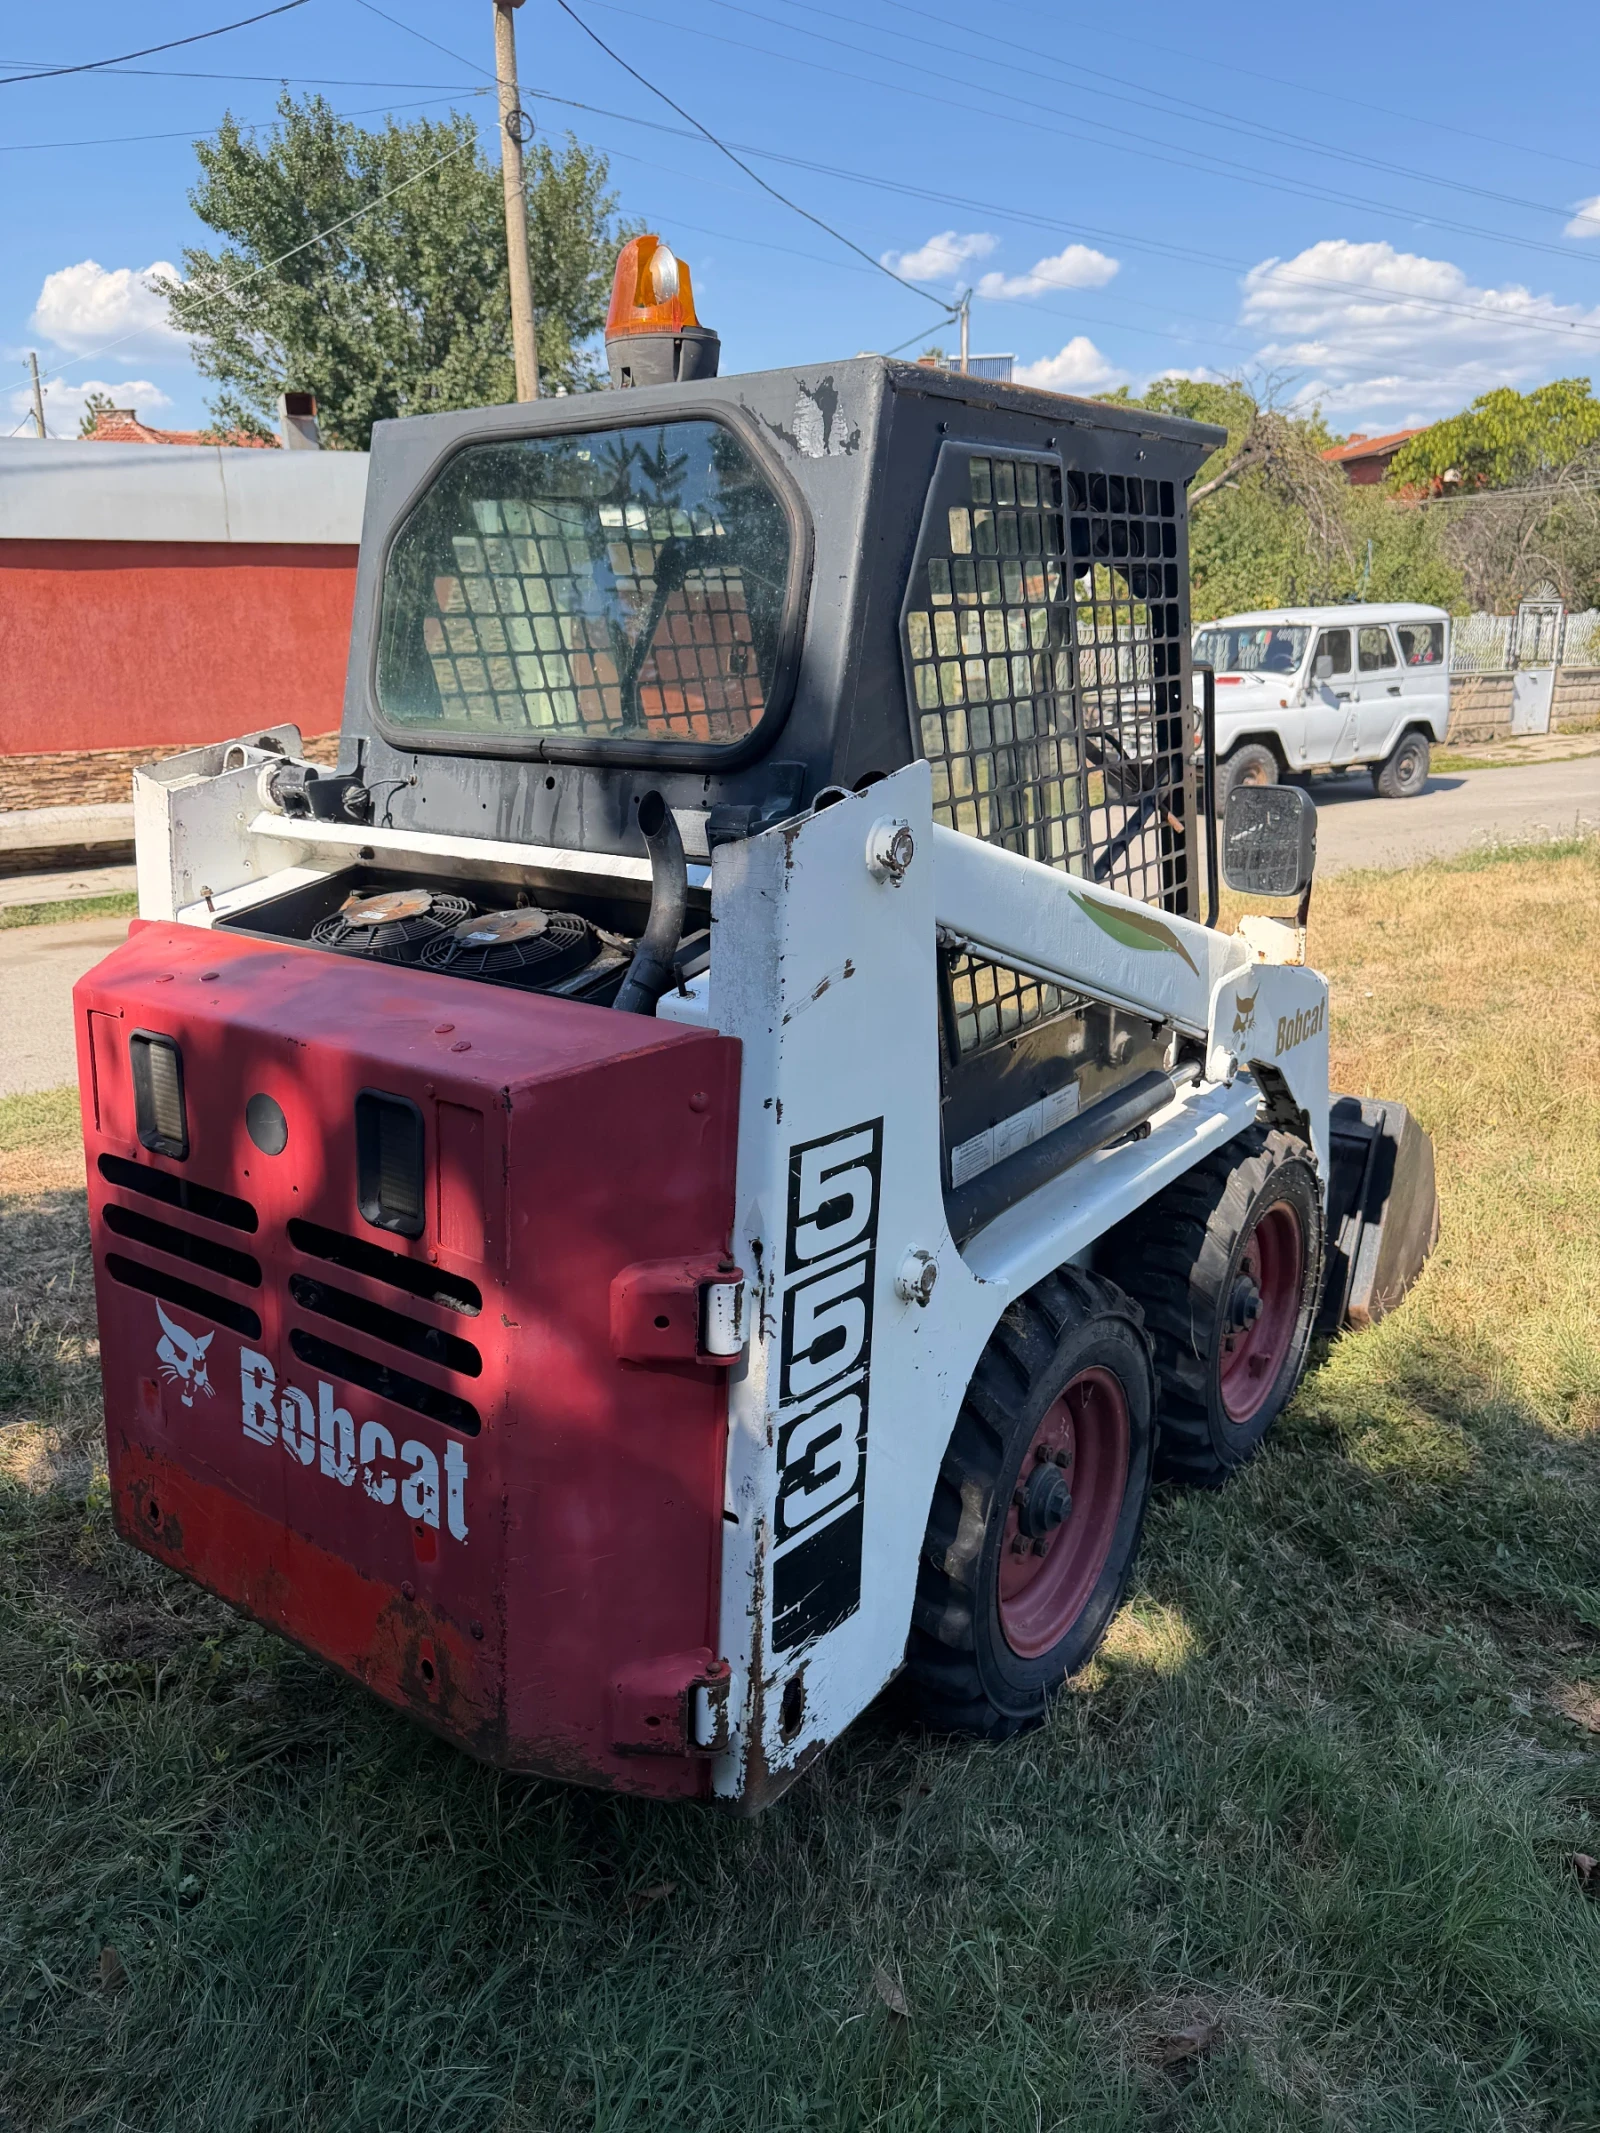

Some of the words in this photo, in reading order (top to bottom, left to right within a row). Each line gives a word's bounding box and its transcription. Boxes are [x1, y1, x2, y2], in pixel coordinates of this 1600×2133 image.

[1275, 996, 1325, 1058] Bobcat
[783, 1127, 873, 1529] 553
[240, 1346, 469, 1542] Bobcat
